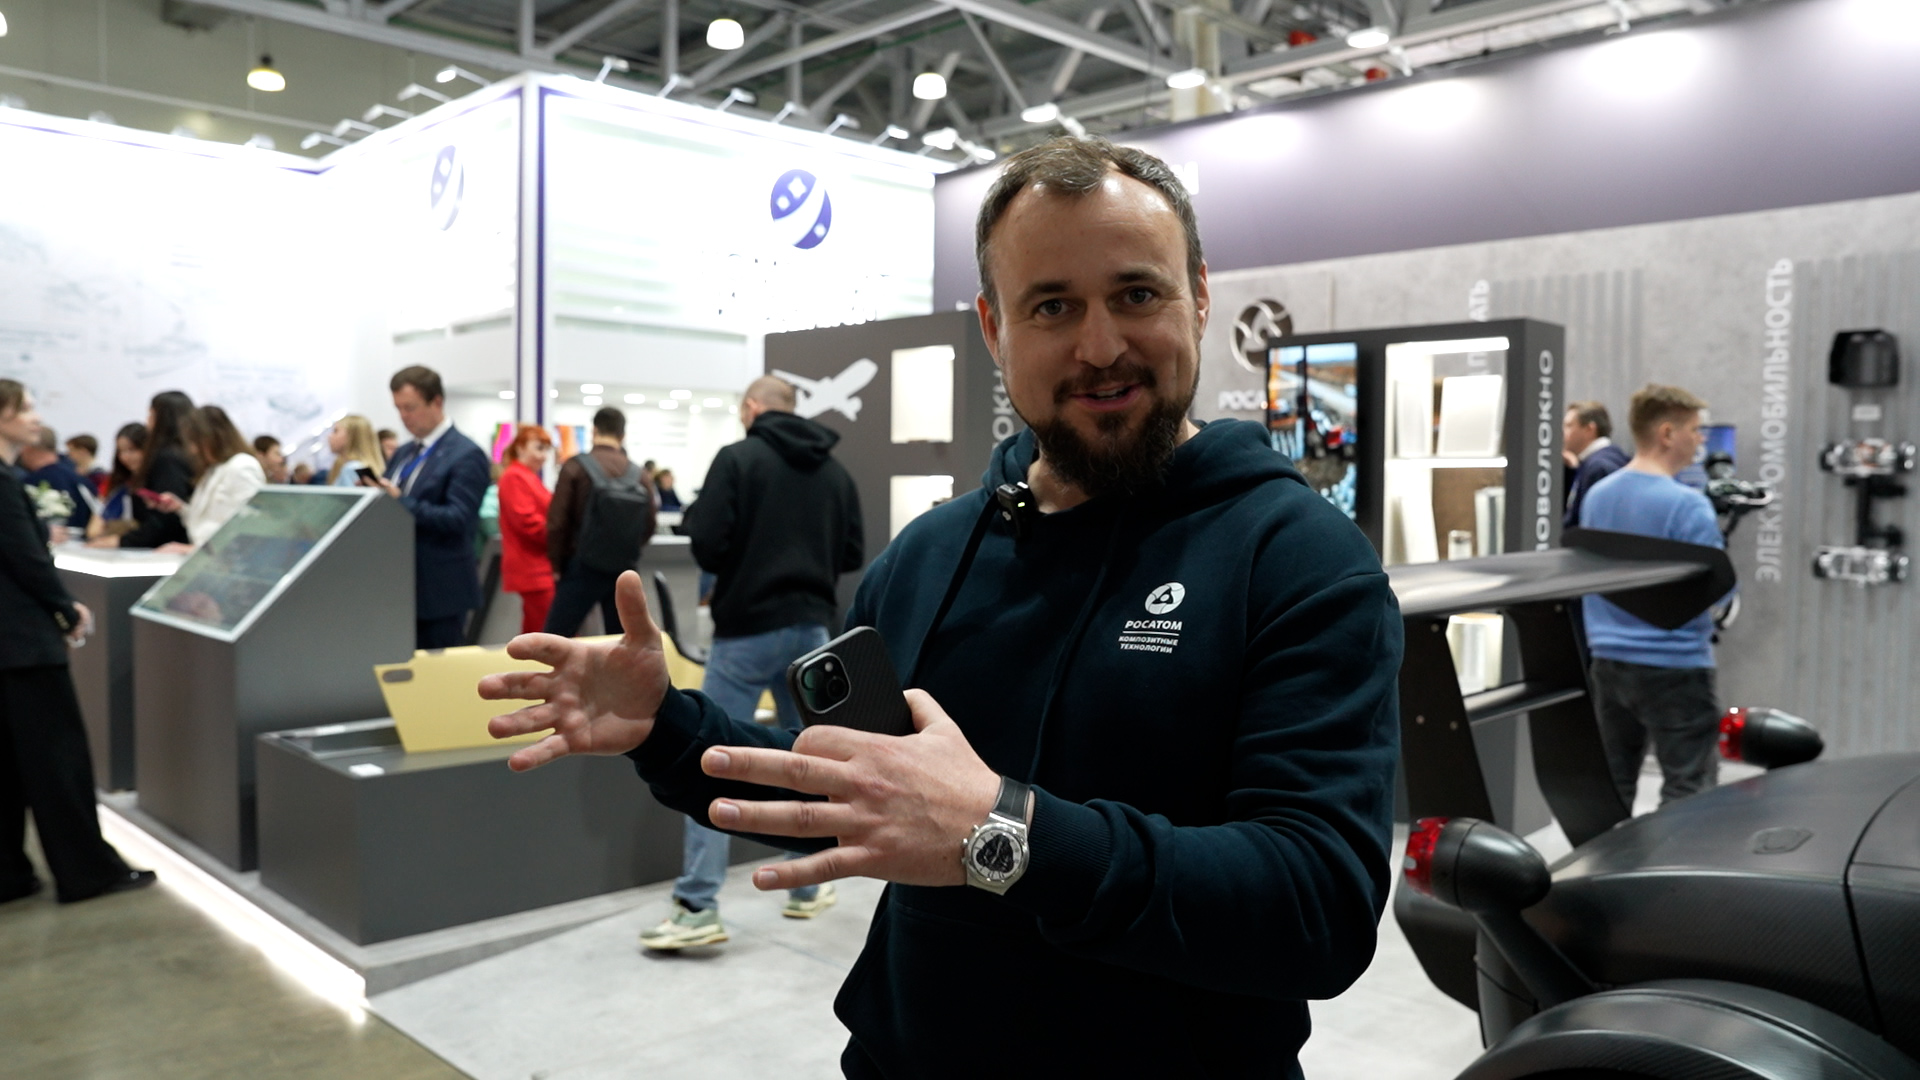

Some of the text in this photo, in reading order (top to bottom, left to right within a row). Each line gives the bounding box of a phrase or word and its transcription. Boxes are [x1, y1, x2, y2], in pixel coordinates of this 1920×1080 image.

[1124, 620, 1182, 630] РОСАТОМ
[1118, 635, 1178, 646] КОМПОЗИТНЫЕ
[1120, 643, 1173, 653] ТЕХНОЛОГИИ
